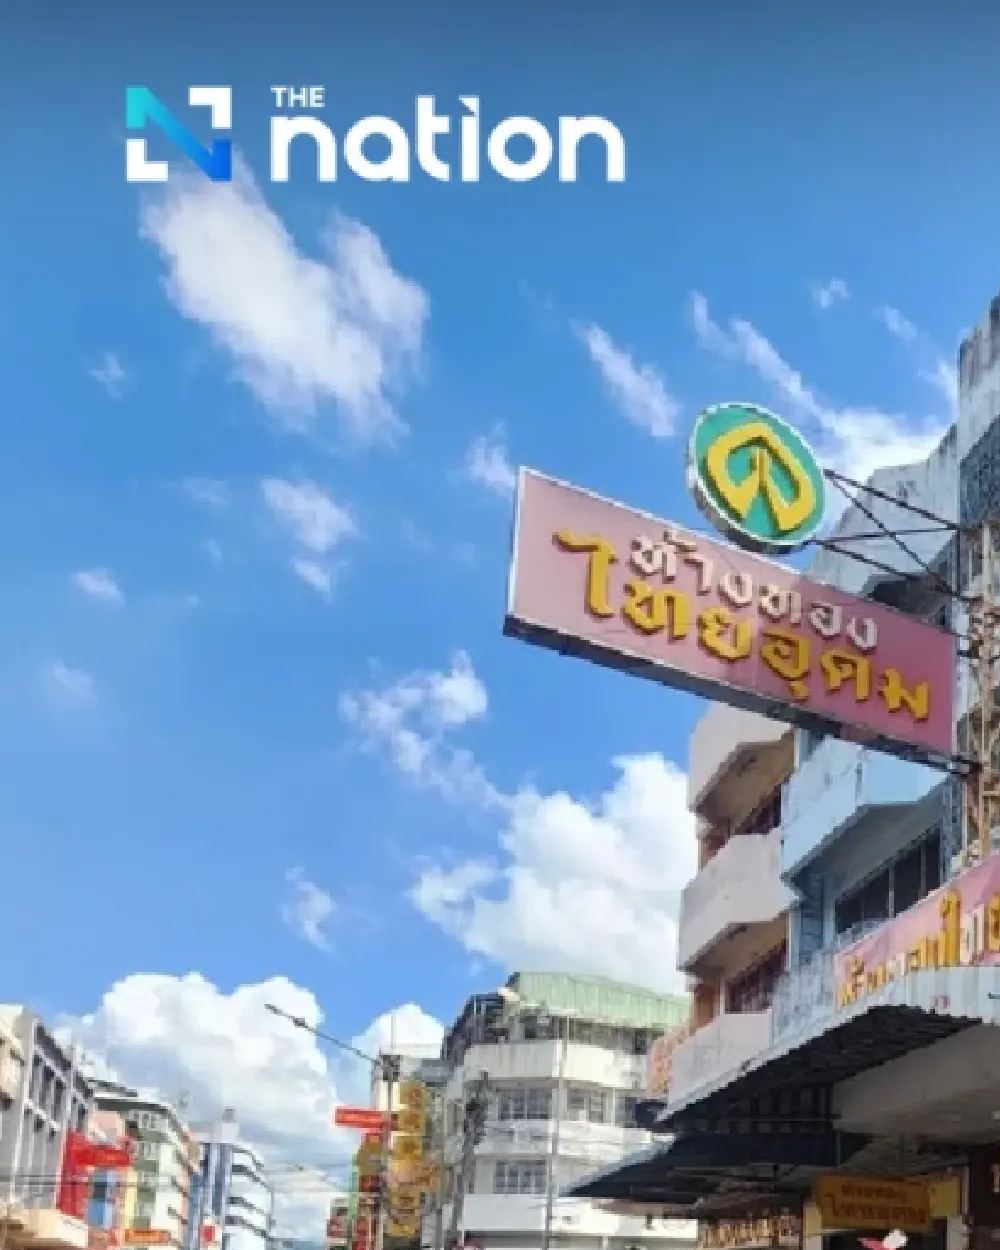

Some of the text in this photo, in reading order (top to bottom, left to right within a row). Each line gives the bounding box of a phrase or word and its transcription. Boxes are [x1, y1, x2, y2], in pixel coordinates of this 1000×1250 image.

[552, 529, 930, 722] ไทยอุดม
[630, 529, 878, 651] ห้างทอง
